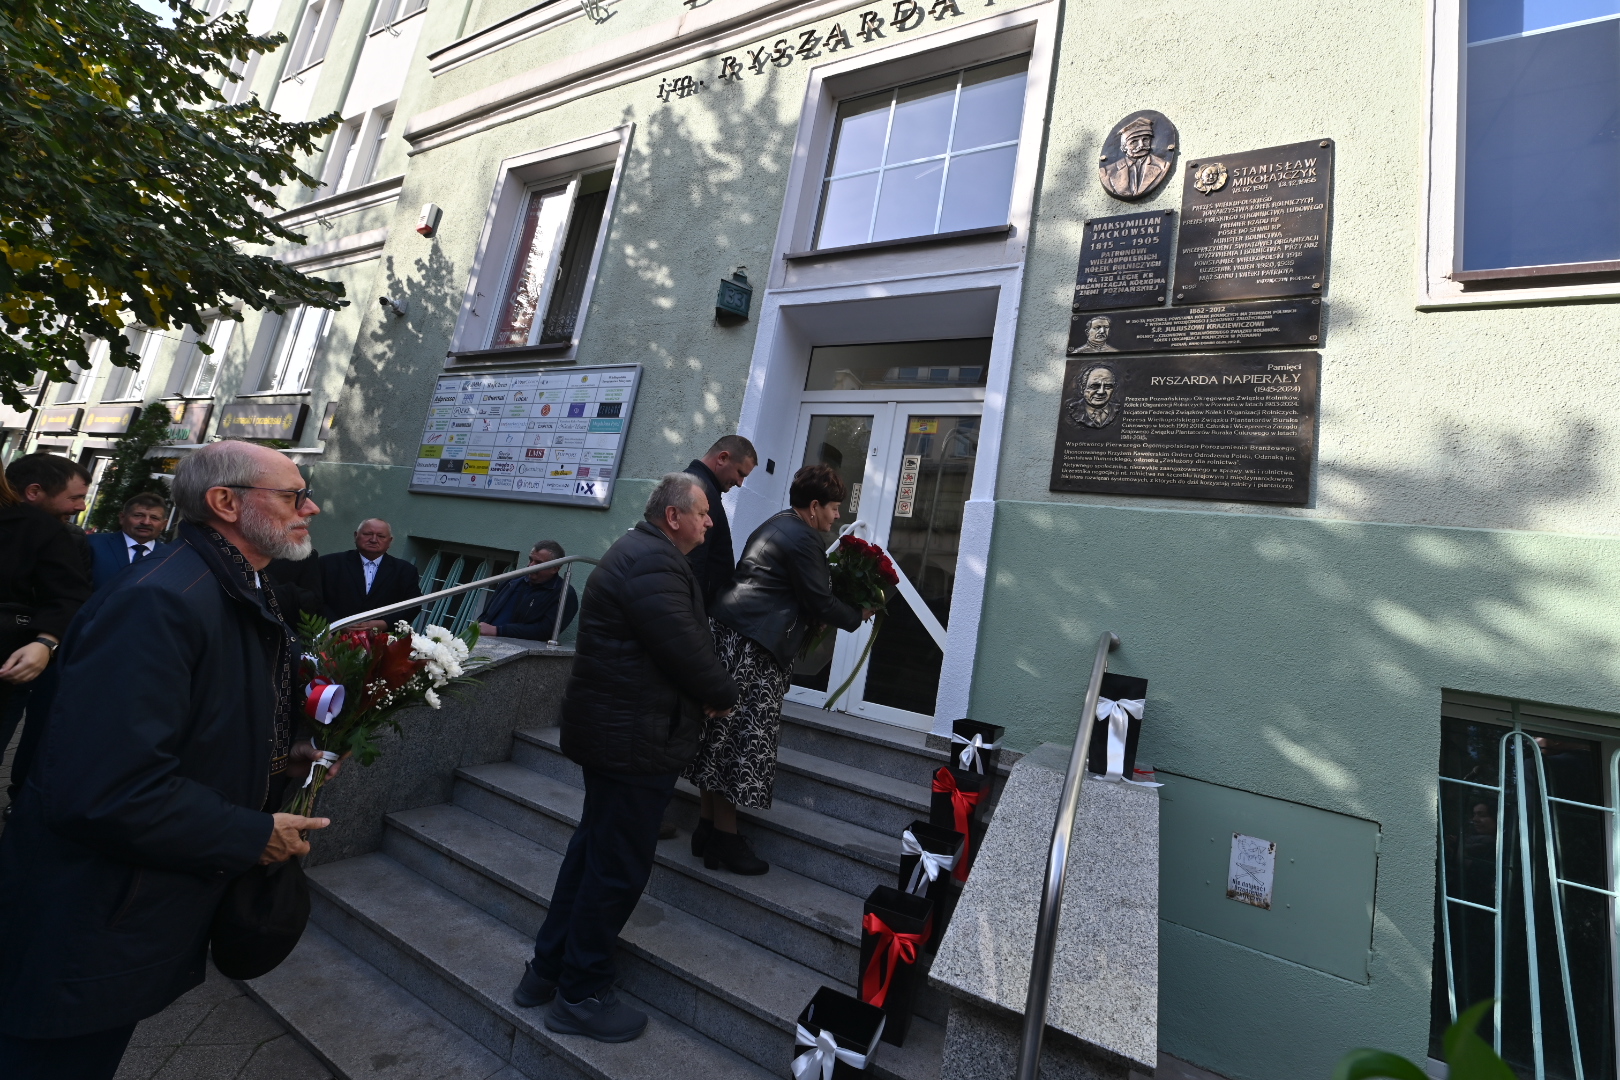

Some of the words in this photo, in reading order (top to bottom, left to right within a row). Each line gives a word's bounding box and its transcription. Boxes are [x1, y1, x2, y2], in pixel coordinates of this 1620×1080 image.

[657, 75, 705, 98] im.
[1233, 157, 1316, 177] STANISŁAW
[1232, 167, 1316, 186] MIKOŁAJCZYK
[1093, 216, 1160, 231] MAKSYMILIAN
[1092, 225, 1159, 240] JACKOWSKI
[1090, 241, 1113, 250] 1815
[1132, 235, 1159, 245] 1905
[1089, 253, 1157, 265] WIELKOPOLSKICH
[1100, 247, 1146, 257] PATRONOWI
[1084, 265, 1108, 273] KÓŁEK
[1112, 260, 1161, 270] ROLNICZYCH
[1206, 320, 1264, 329] KRAZIEWICZOWI
[1267, 363, 1301, 371] Pamięci
[1150, 375, 1218, 385] RYSZARDA
[1222, 373, 1300, 384] NAPIERAŁY
